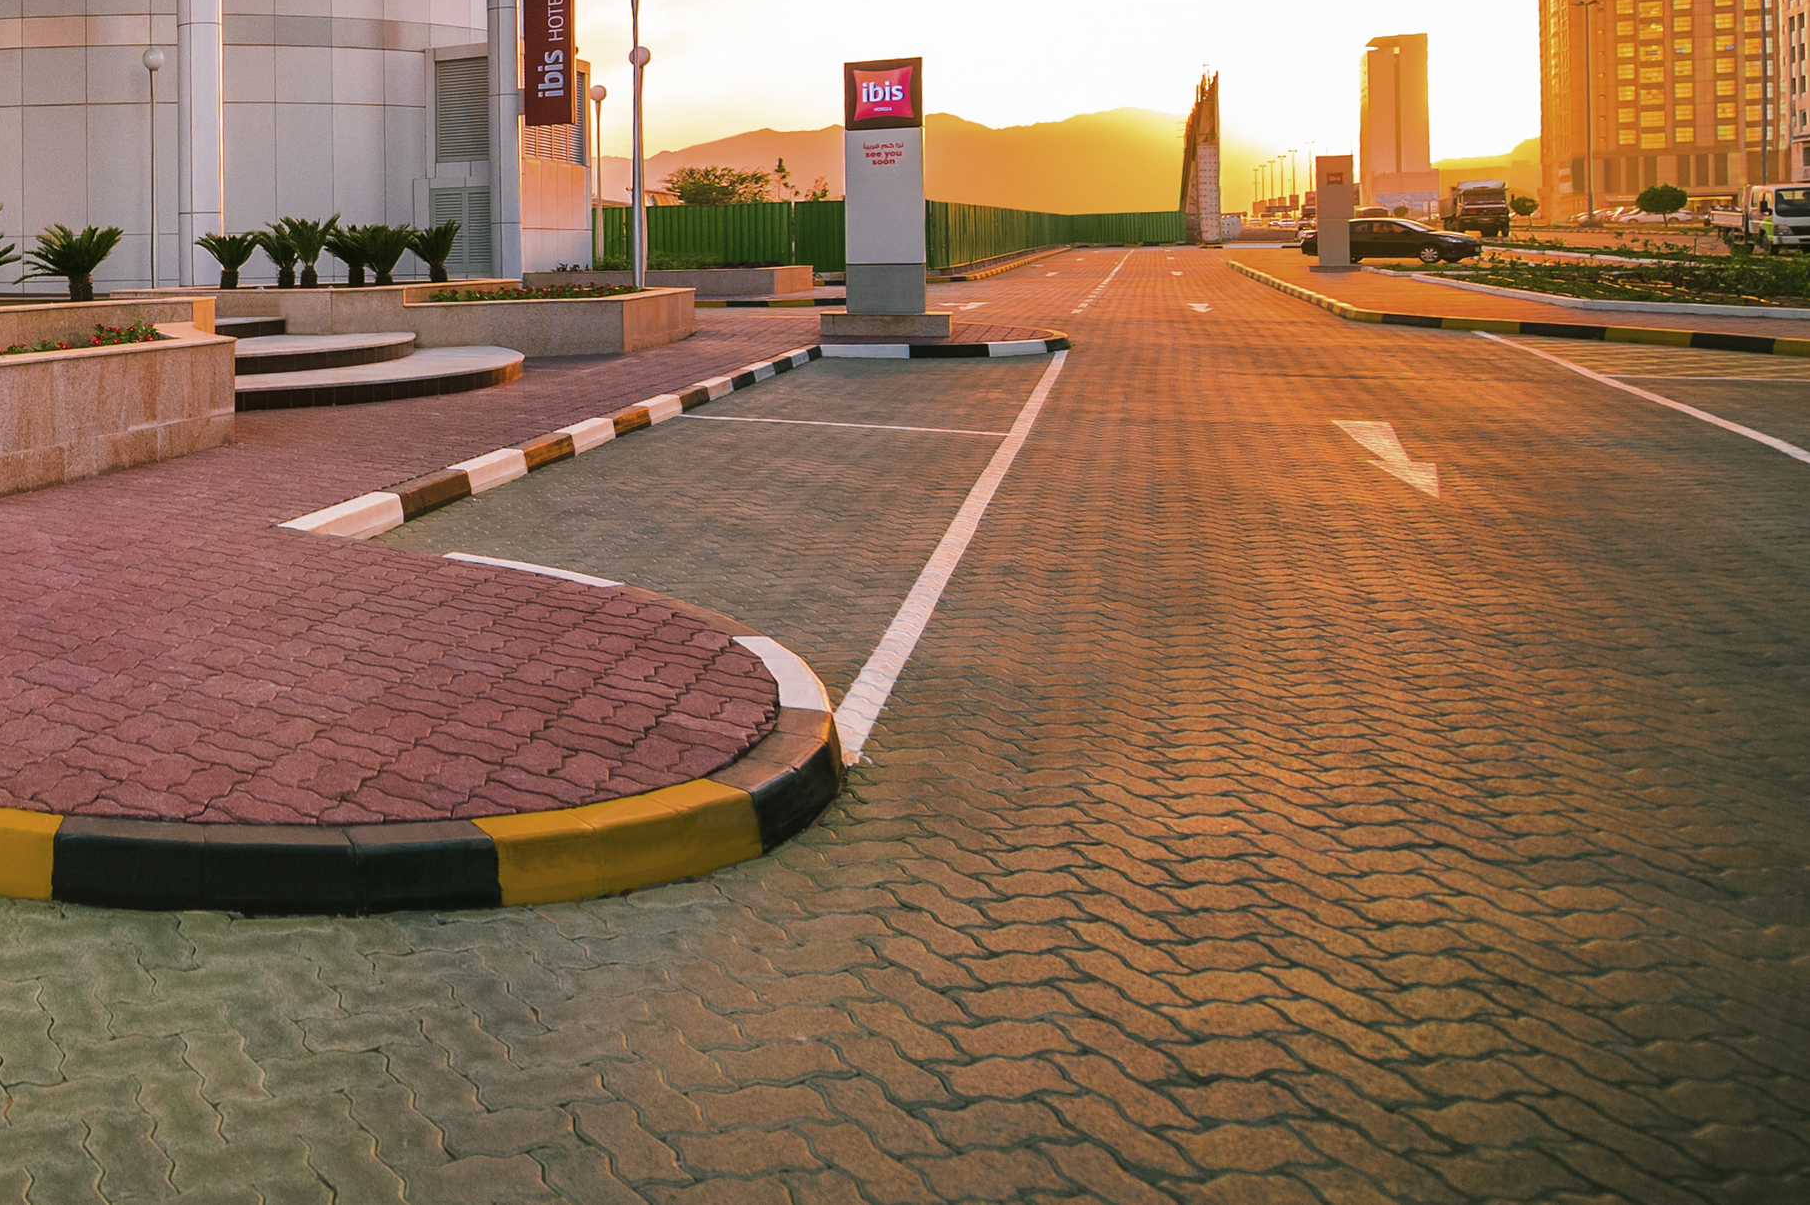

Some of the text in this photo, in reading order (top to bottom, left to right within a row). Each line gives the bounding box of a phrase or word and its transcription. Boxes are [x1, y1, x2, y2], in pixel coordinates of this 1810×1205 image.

[538, 49, 565, 98] ibis
[862, 81, 904, 103] ibis
[884, 151, 902, 159] you
